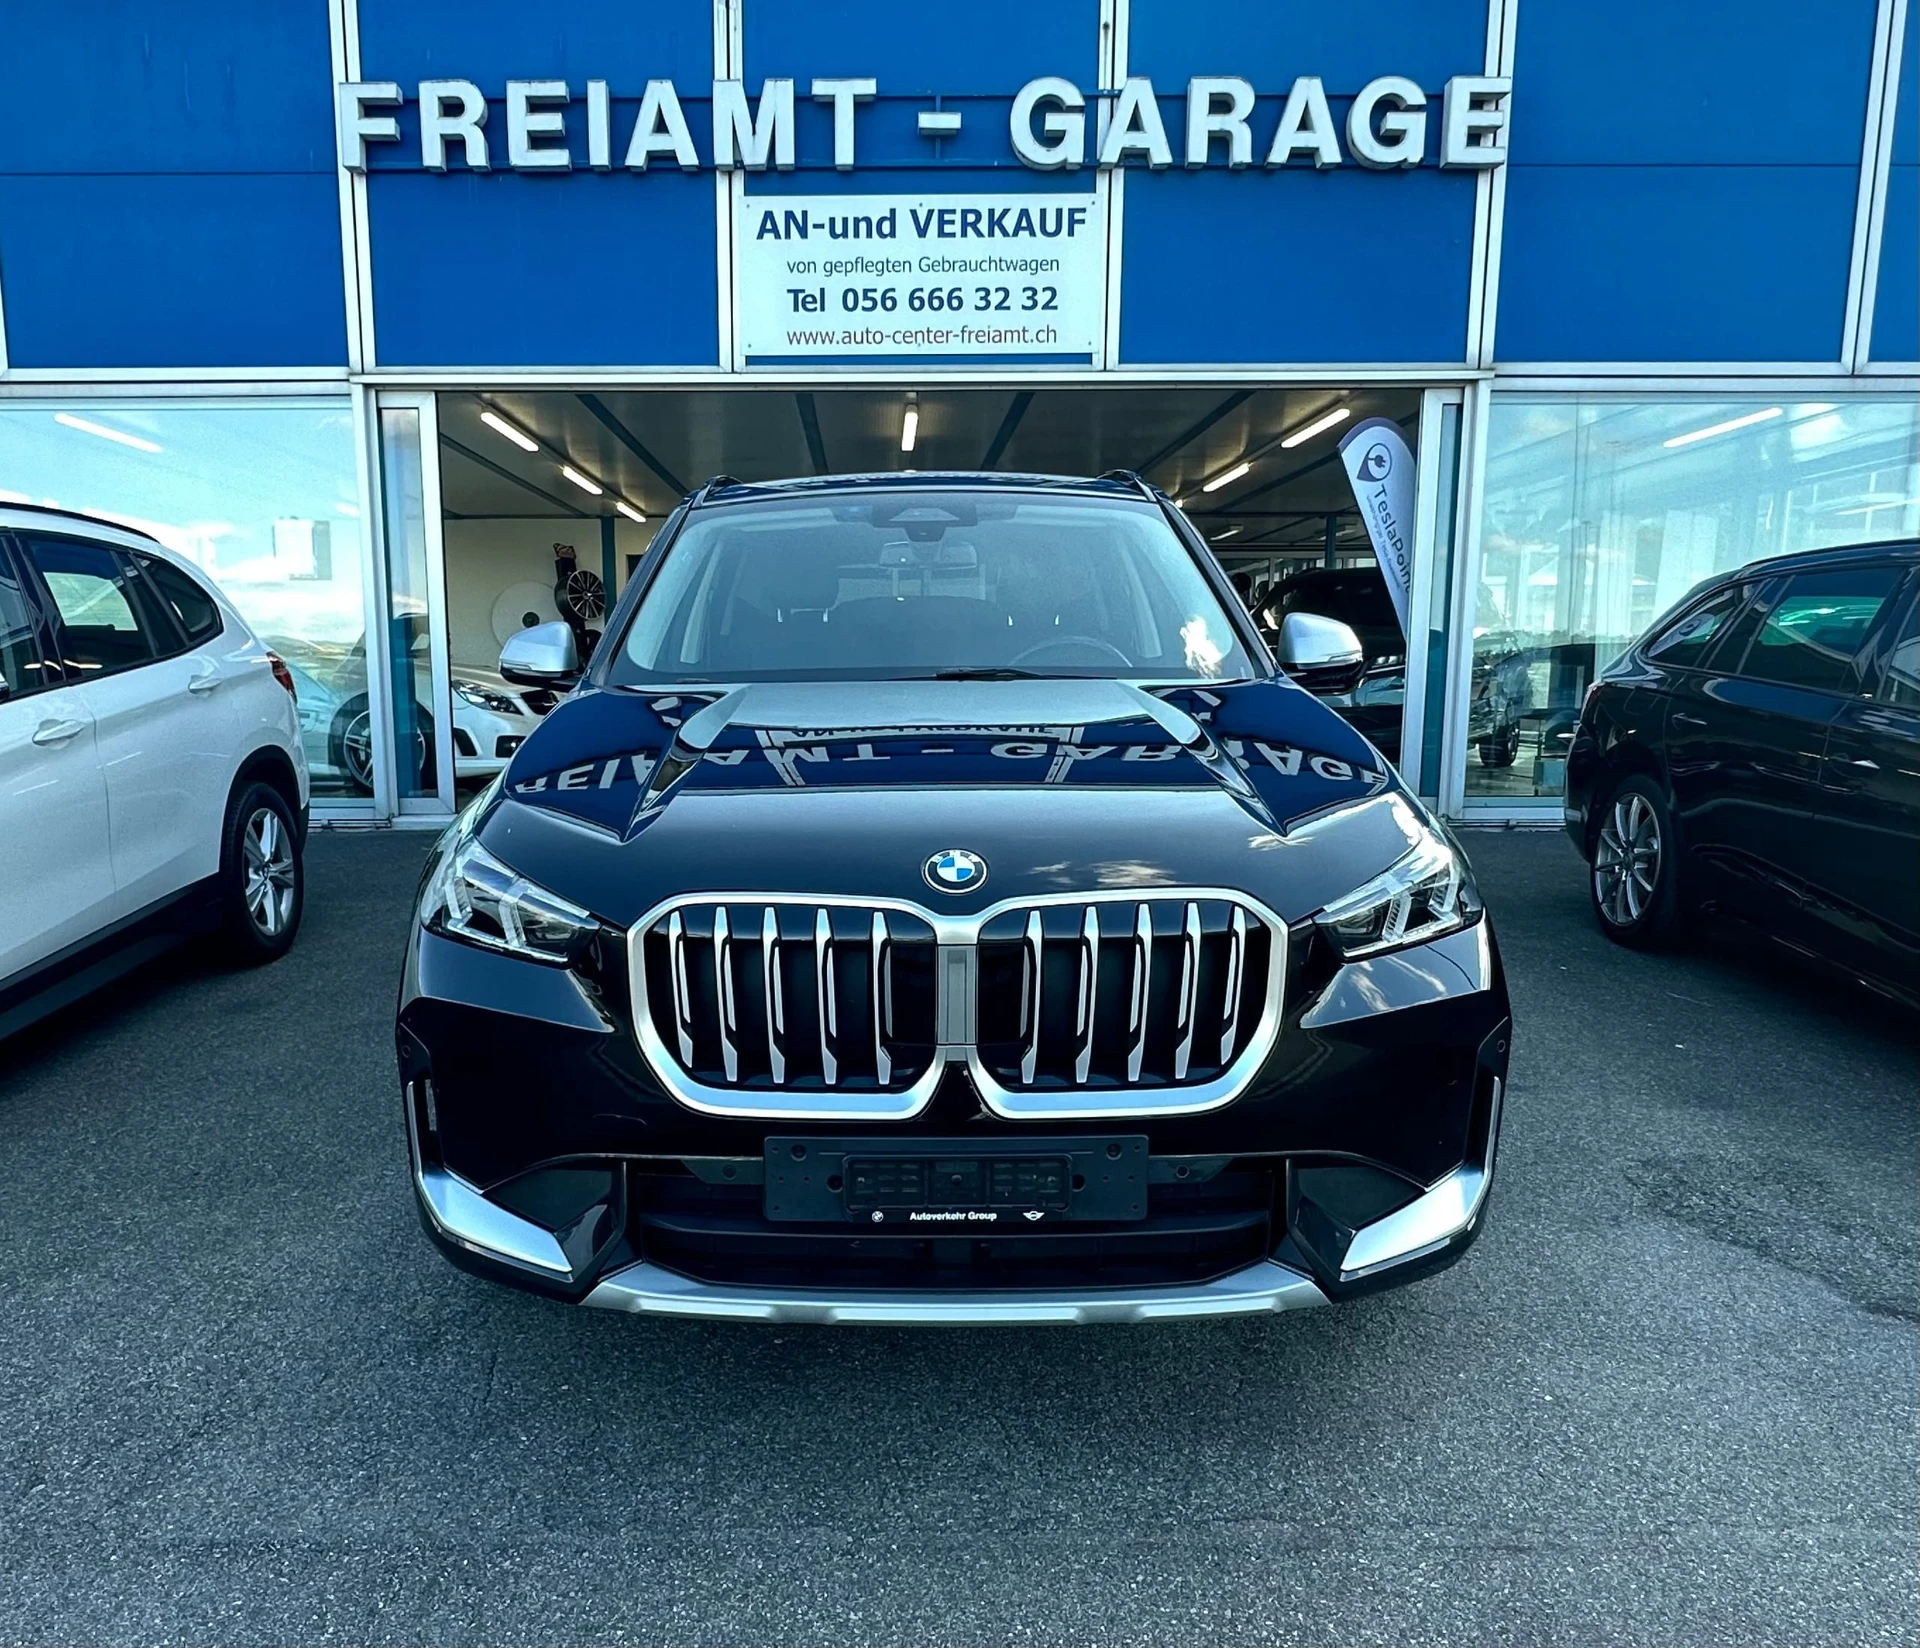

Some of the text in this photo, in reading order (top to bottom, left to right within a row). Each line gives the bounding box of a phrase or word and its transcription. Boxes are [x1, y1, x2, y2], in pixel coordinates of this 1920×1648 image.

[339, 76, 1512, 174] FREIAMT - GARAGE
[756, 206, 1087, 240] AN-und VERKAUF
[786, 255, 1060, 277] von gepflegten Gebrauchtwagen
[786, 286, 1059, 313] Tel 056 666 32 32
[786, 324, 1058, 346] www.auto-center-freiamt.ch
[909, 1211, 998, 1221] Autoverkehr Group
